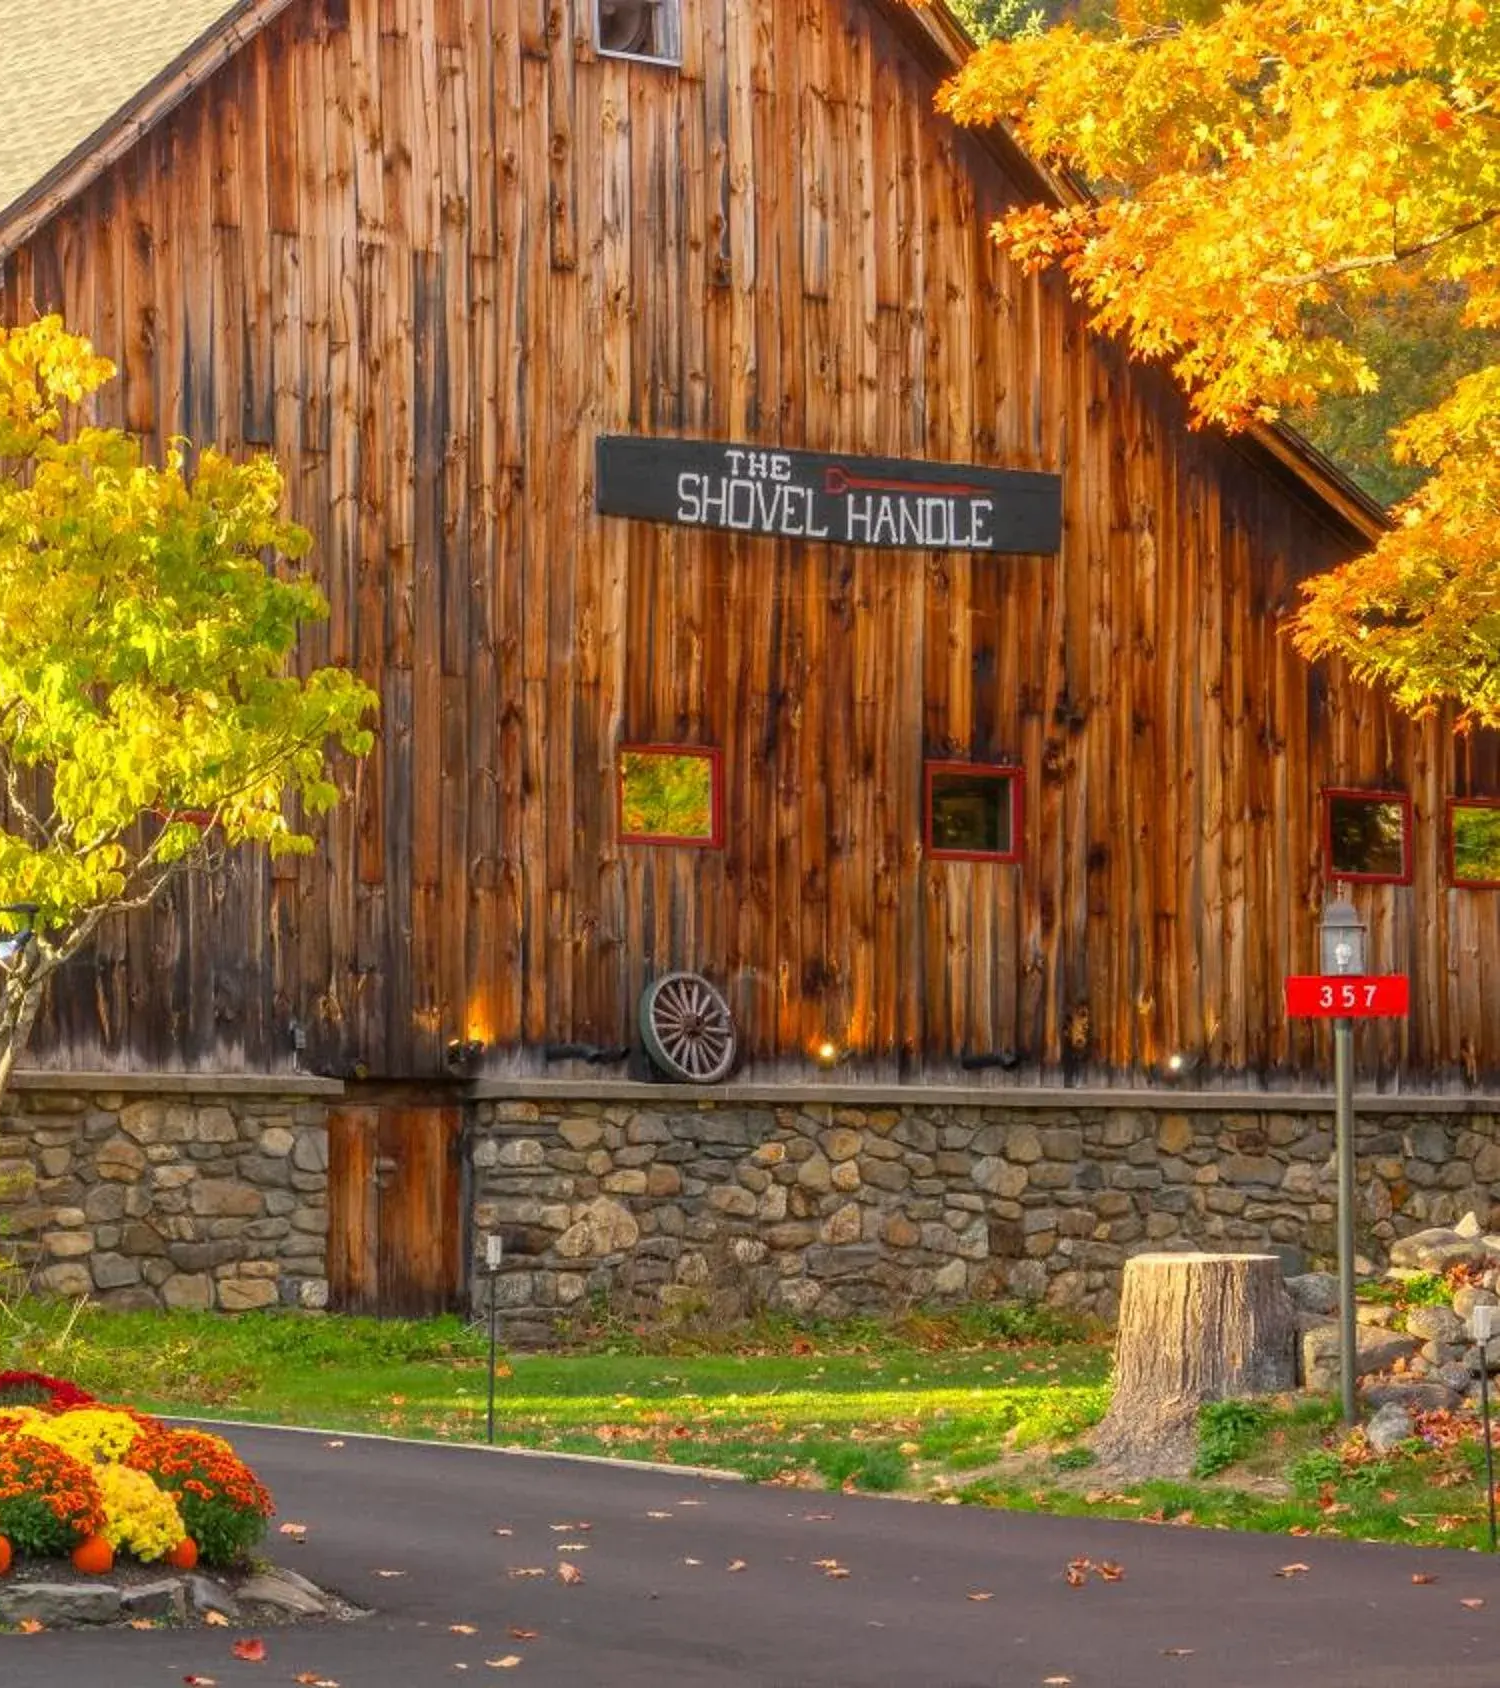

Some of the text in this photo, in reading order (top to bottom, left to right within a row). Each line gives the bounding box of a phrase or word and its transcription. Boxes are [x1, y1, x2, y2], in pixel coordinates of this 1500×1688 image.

[724, 449, 792, 481] THE
[676, 472, 994, 548] SHOVEL HANDLE
[1319, 985, 1377, 1008] 357
